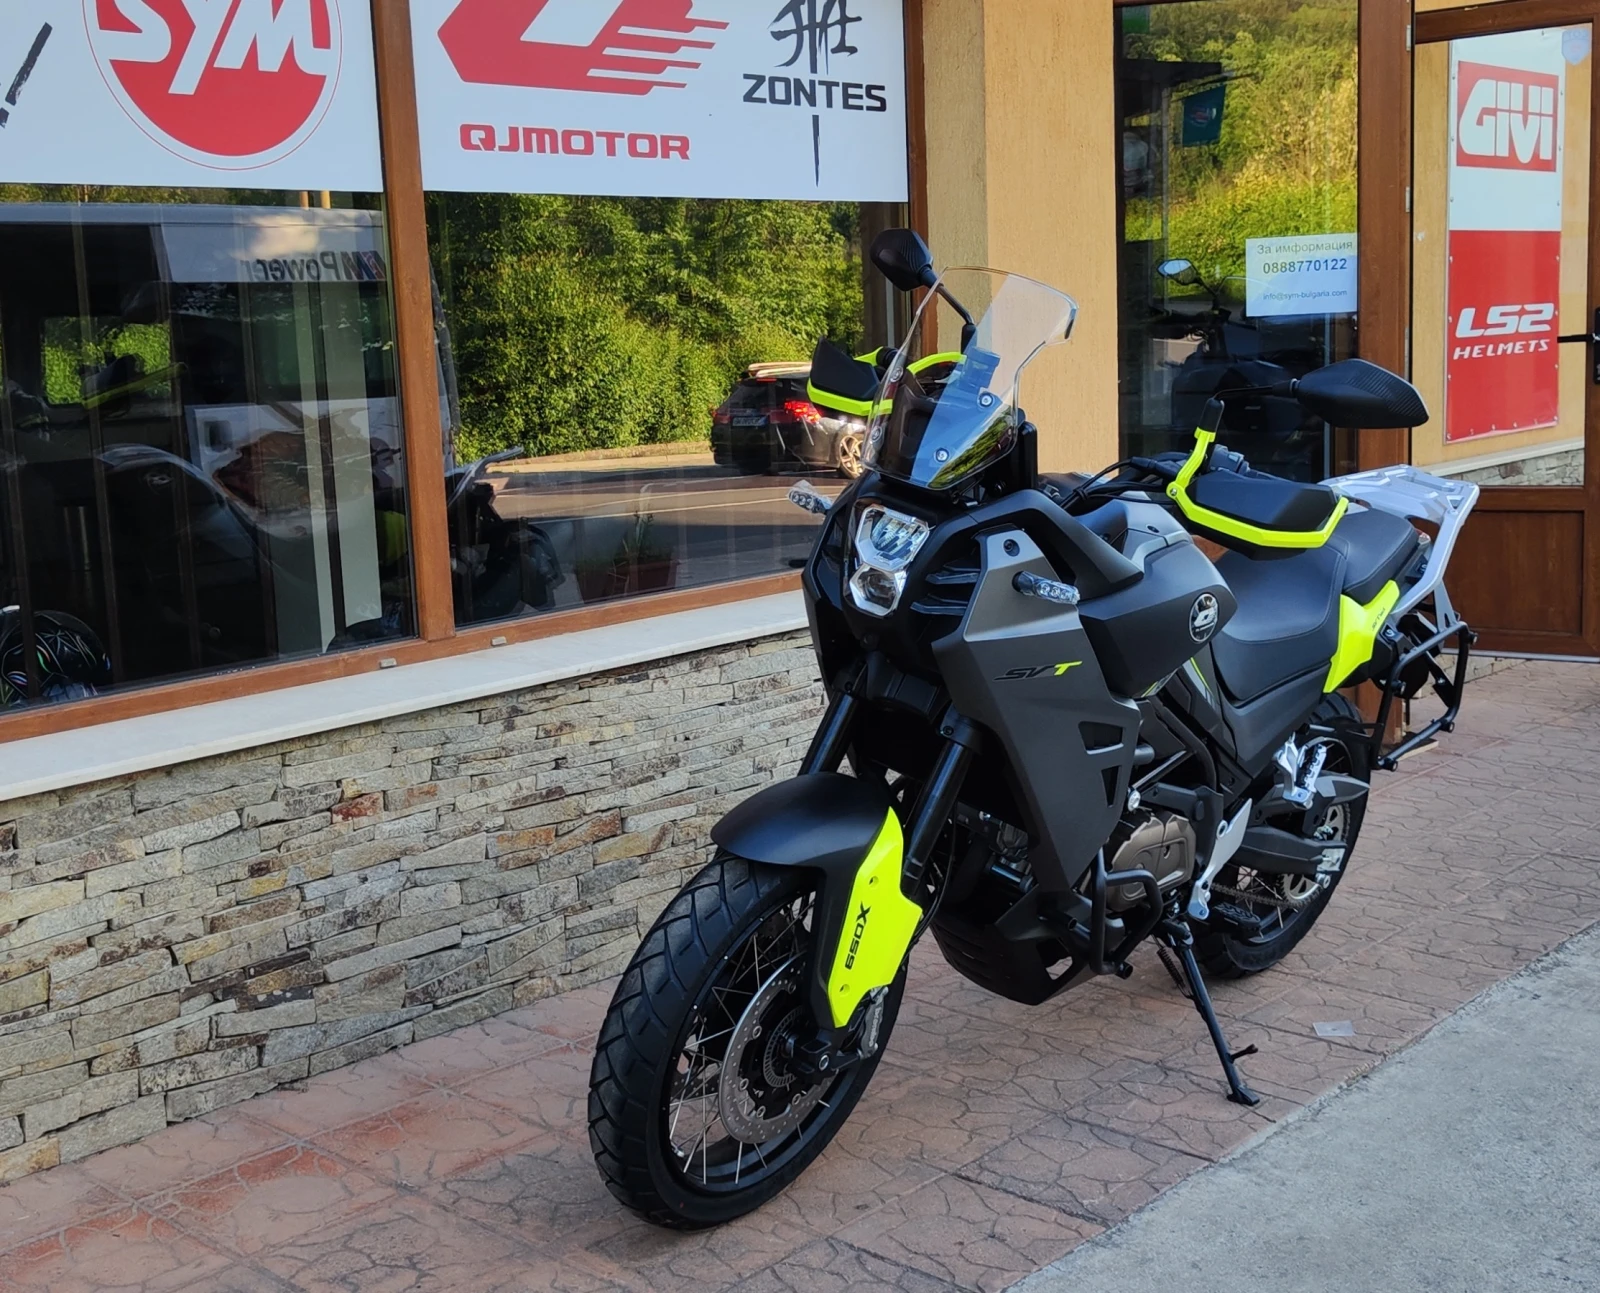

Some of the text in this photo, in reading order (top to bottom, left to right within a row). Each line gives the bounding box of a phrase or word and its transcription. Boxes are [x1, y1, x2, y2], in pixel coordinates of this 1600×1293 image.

[98, 0, 330, 95] SYM
[743, 73, 887, 112] ZONTES
[459, 124, 690, 160] QJMOTOR
[1257, 243, 1272, 255] За
[1263, 258, 1348, 274] 0888770122
[1263, 290, 1348, 301] info@sym-bulgaria.com
[1455, 303, 1554, 338] LS2
[1453, 339, 1550, 360] HELMETS
[993, 660, 1083, 680] SVT
[845, 901, 871, 970] 650X
